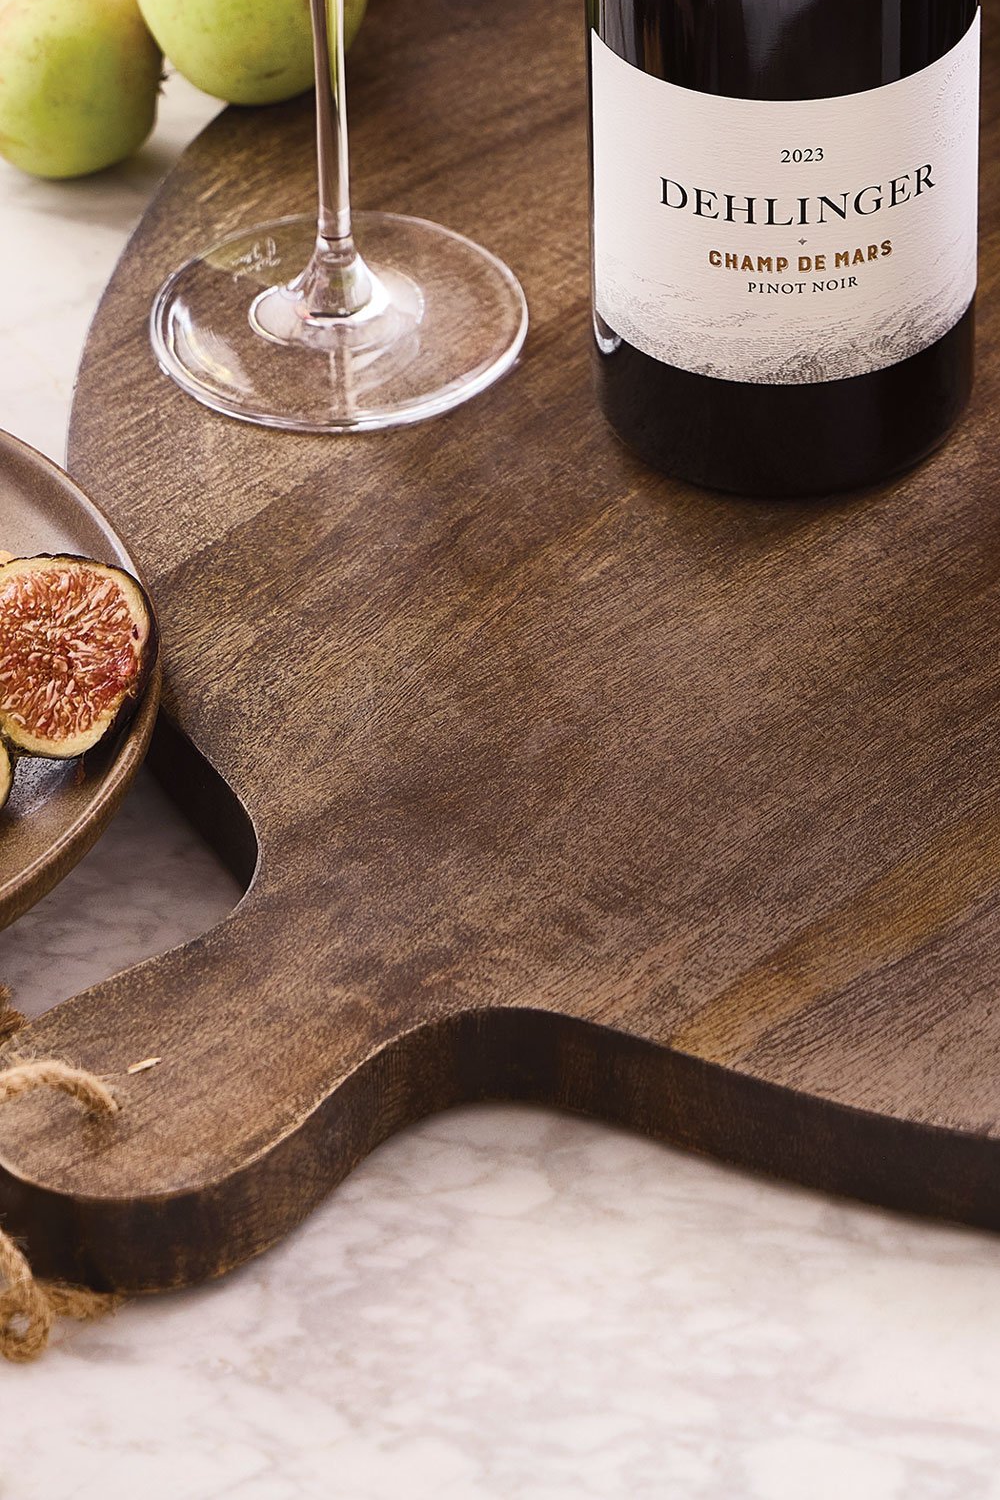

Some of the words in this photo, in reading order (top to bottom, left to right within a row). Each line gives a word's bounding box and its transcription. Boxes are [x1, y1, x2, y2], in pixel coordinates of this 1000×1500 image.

[780, 147, 824, 164] 2023
[659, 163, 936, 226] DEHLINGER
[708, 250, 789, 274] CHAMP
[797, 256, 827, 273] DE
[834, 239, 893, 269] MARS
[747, 281, 807, 295] PINOT
[811, 276, 859, 293] NOIR
